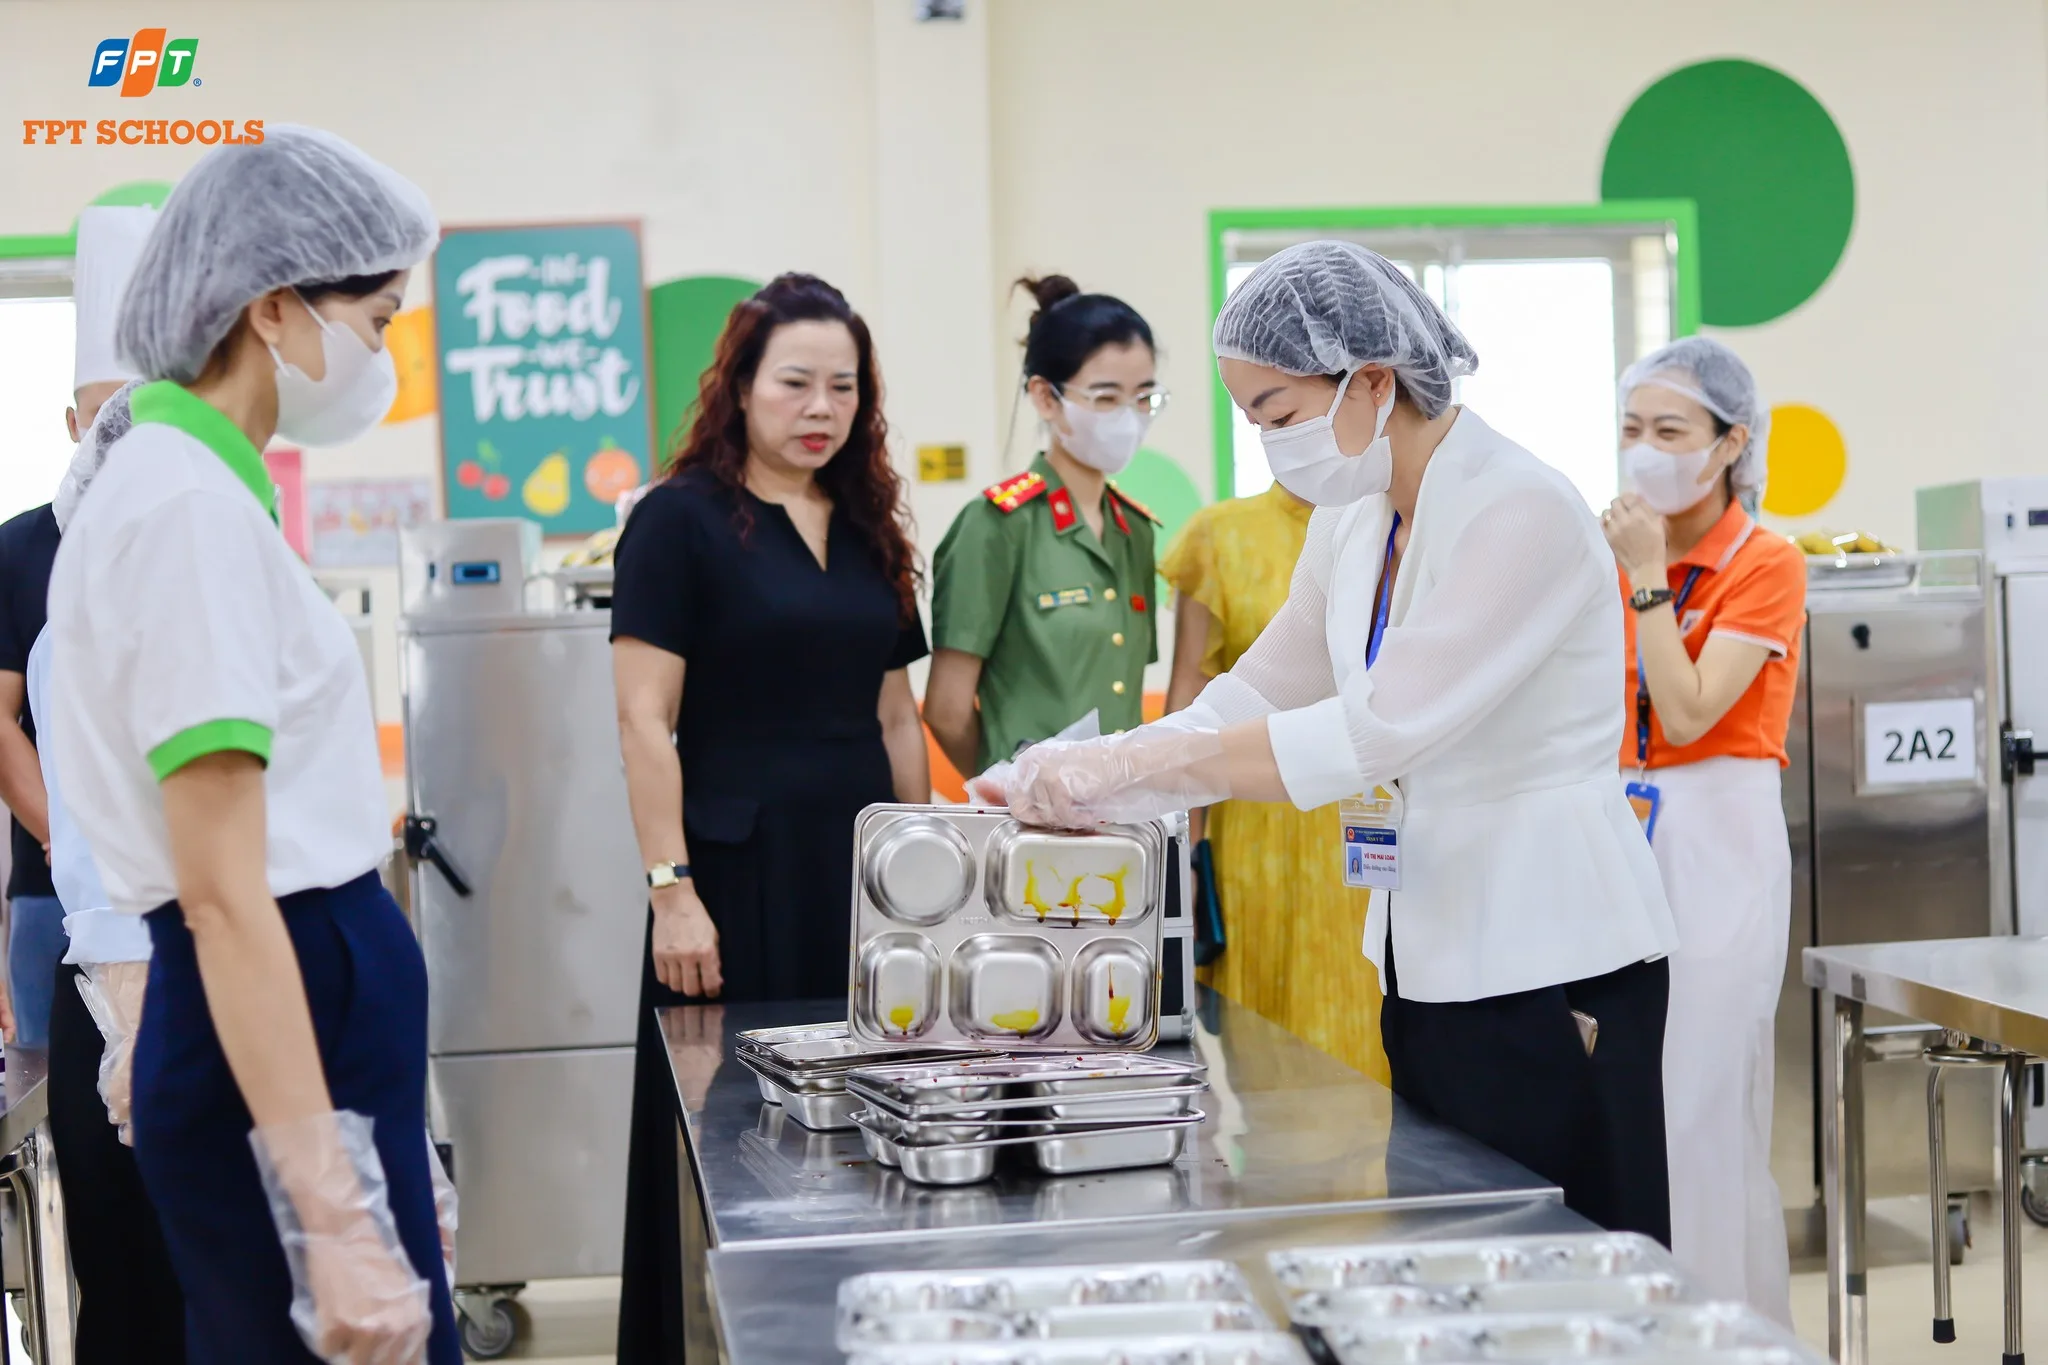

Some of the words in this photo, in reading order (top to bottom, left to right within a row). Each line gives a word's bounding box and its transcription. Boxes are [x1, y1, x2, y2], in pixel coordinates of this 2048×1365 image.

[456, 254, 622, 344] Food
[445, 344, 640, 423] Trust
[1885, 728, 1956, 763] 2A2
